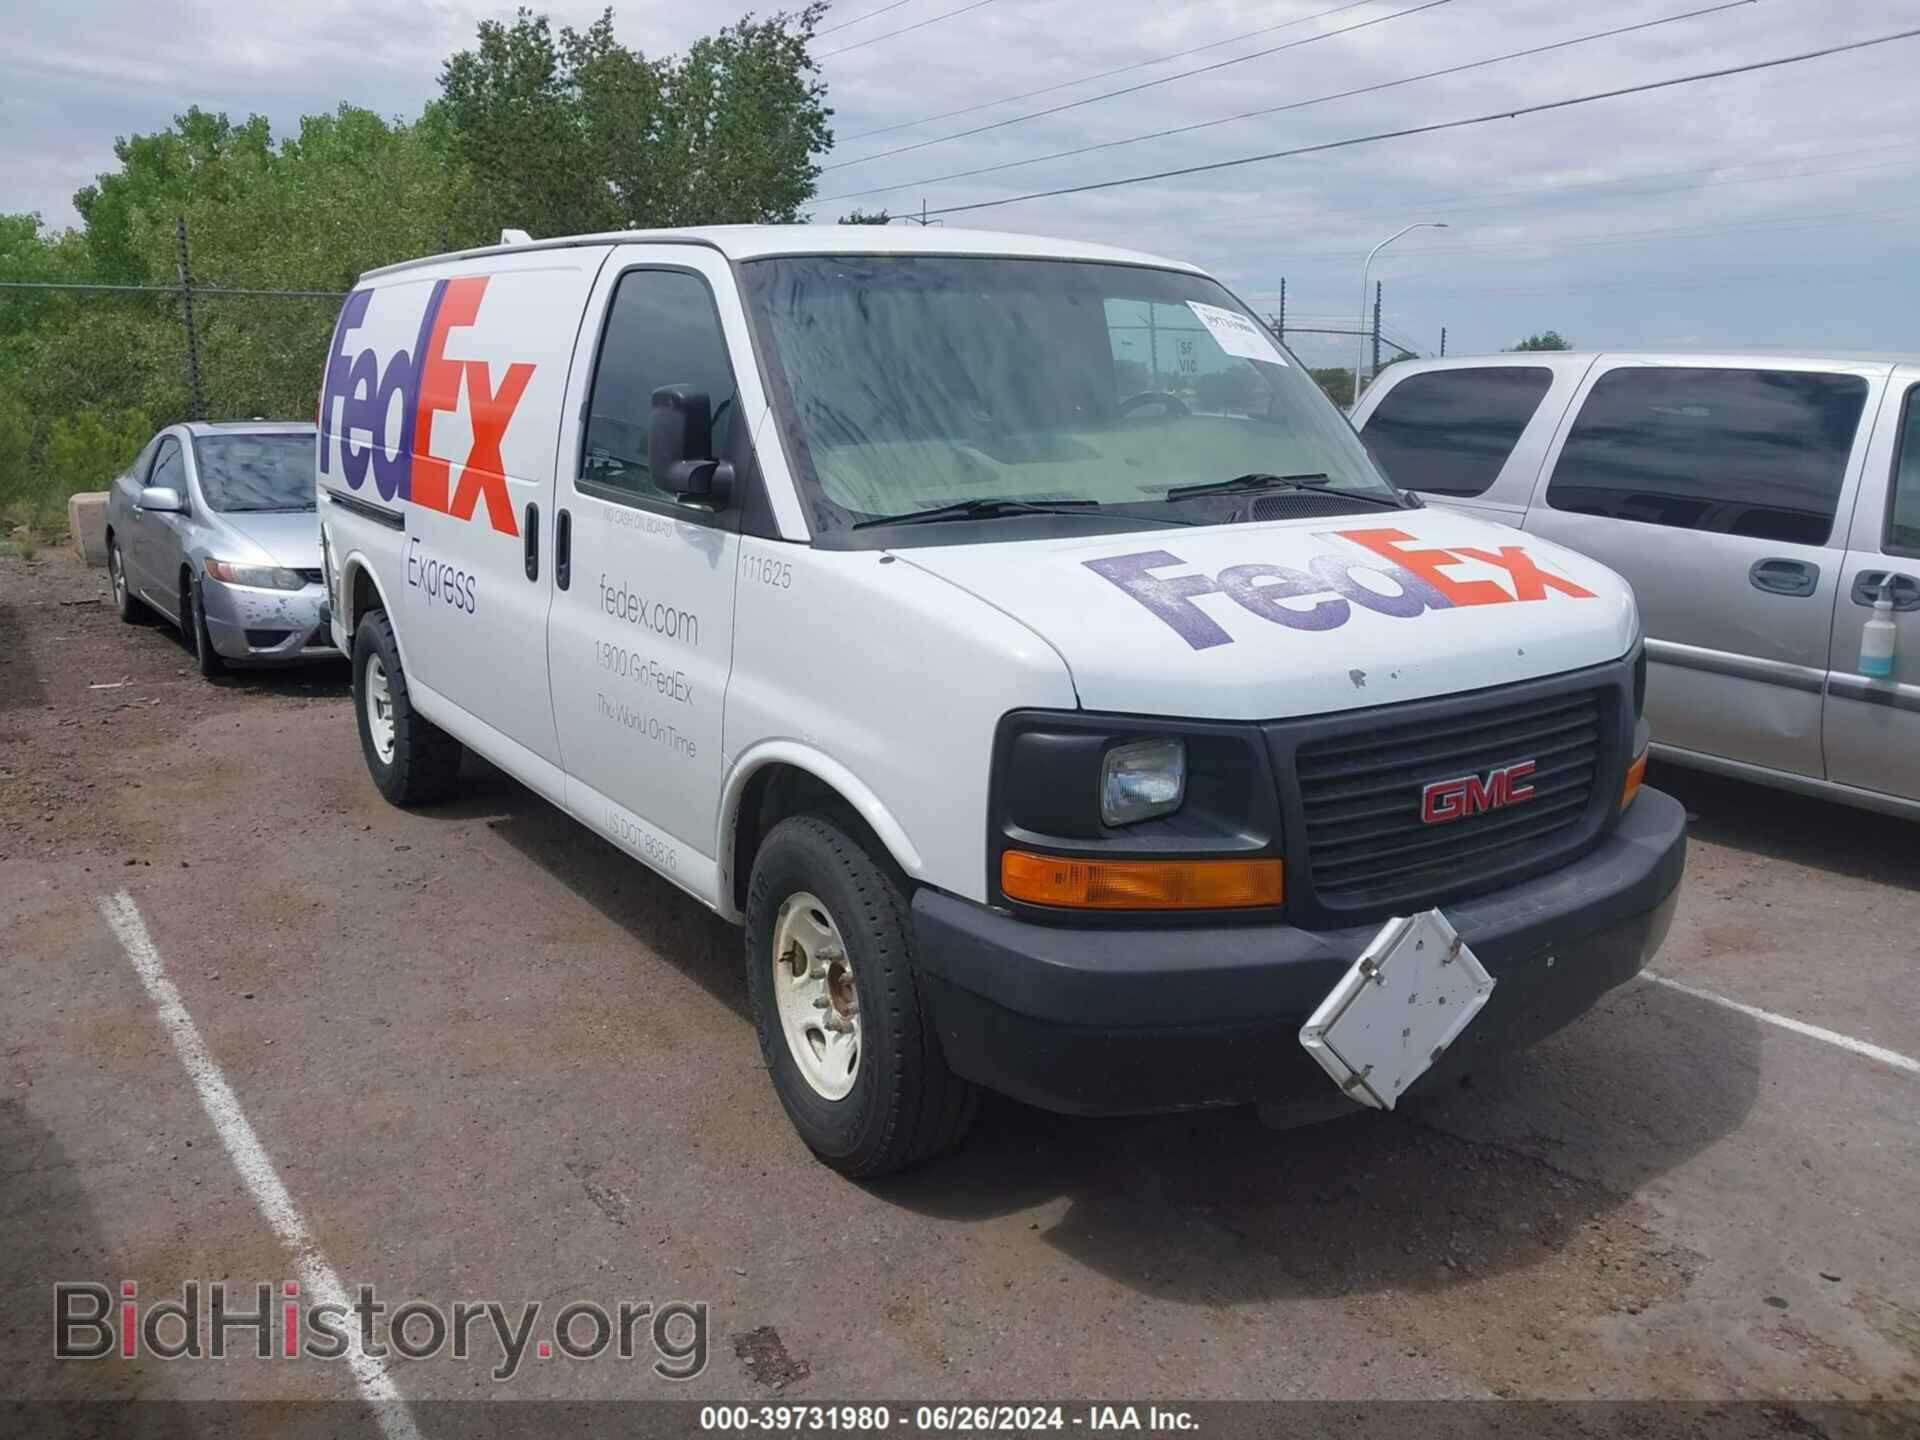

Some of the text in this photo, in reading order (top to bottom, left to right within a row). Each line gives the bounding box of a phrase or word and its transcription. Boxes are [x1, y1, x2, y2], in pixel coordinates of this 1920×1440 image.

[320, 276, 538, 537] FedEx
[408, 536, 476, 614] Express
[742, 554, 792, 589] 111625
[1081, 528, 1598, 651] FedEx
[600, 573, 698, 645] fedex.com
[649, 718, 665, 745] On
[667, 726, 696, 758] Time
[1420, 759, 1536, 823] GMC
[621, 818, 642, 847] DOT
